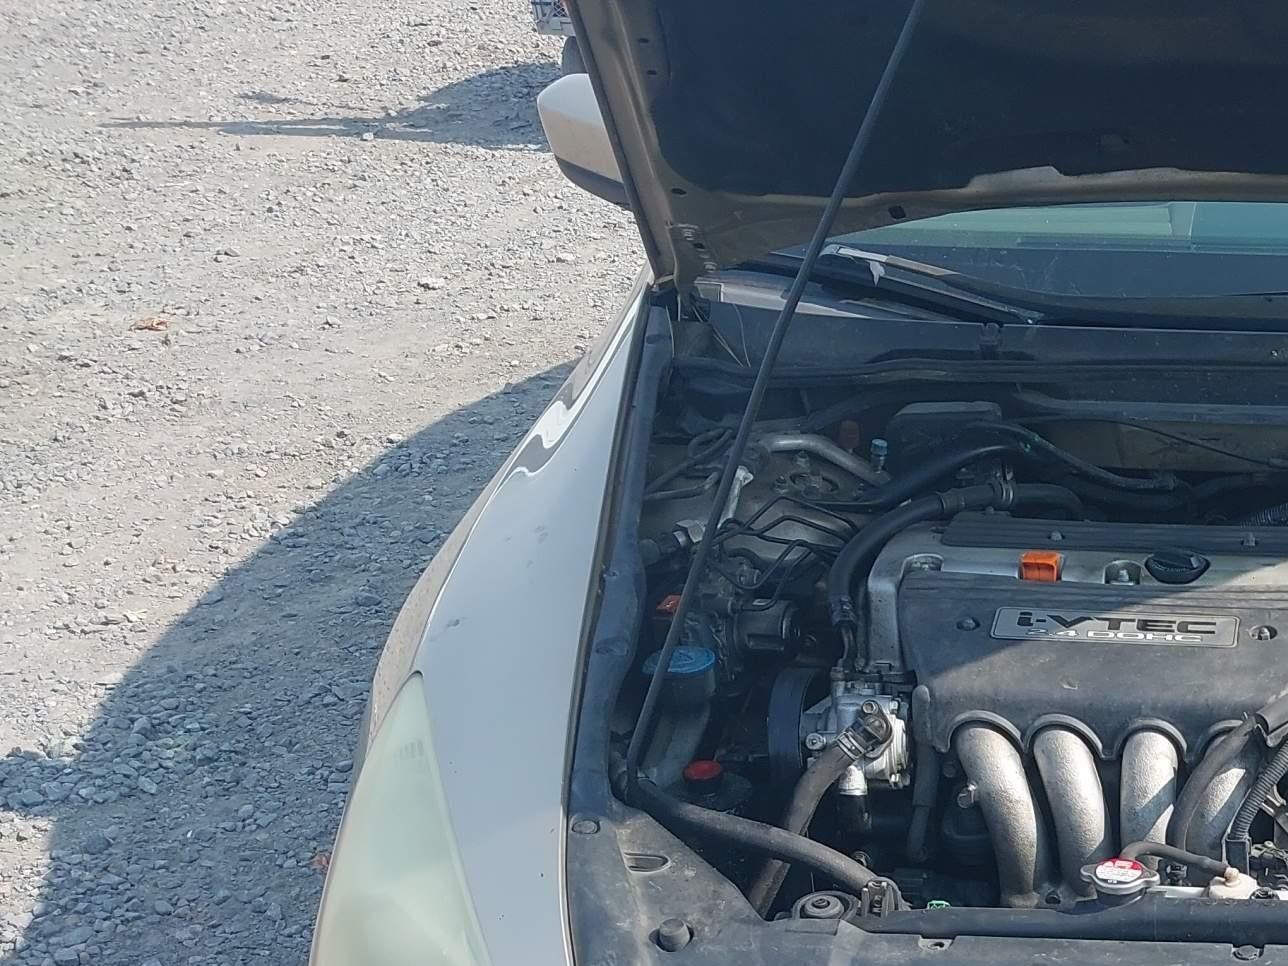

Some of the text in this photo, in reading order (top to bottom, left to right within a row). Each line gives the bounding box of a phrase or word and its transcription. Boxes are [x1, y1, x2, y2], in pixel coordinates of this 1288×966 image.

[1016, 611, 1217, 635] i-VTEC
[1026, 628, 1204, 642] 2.4 DOHC
